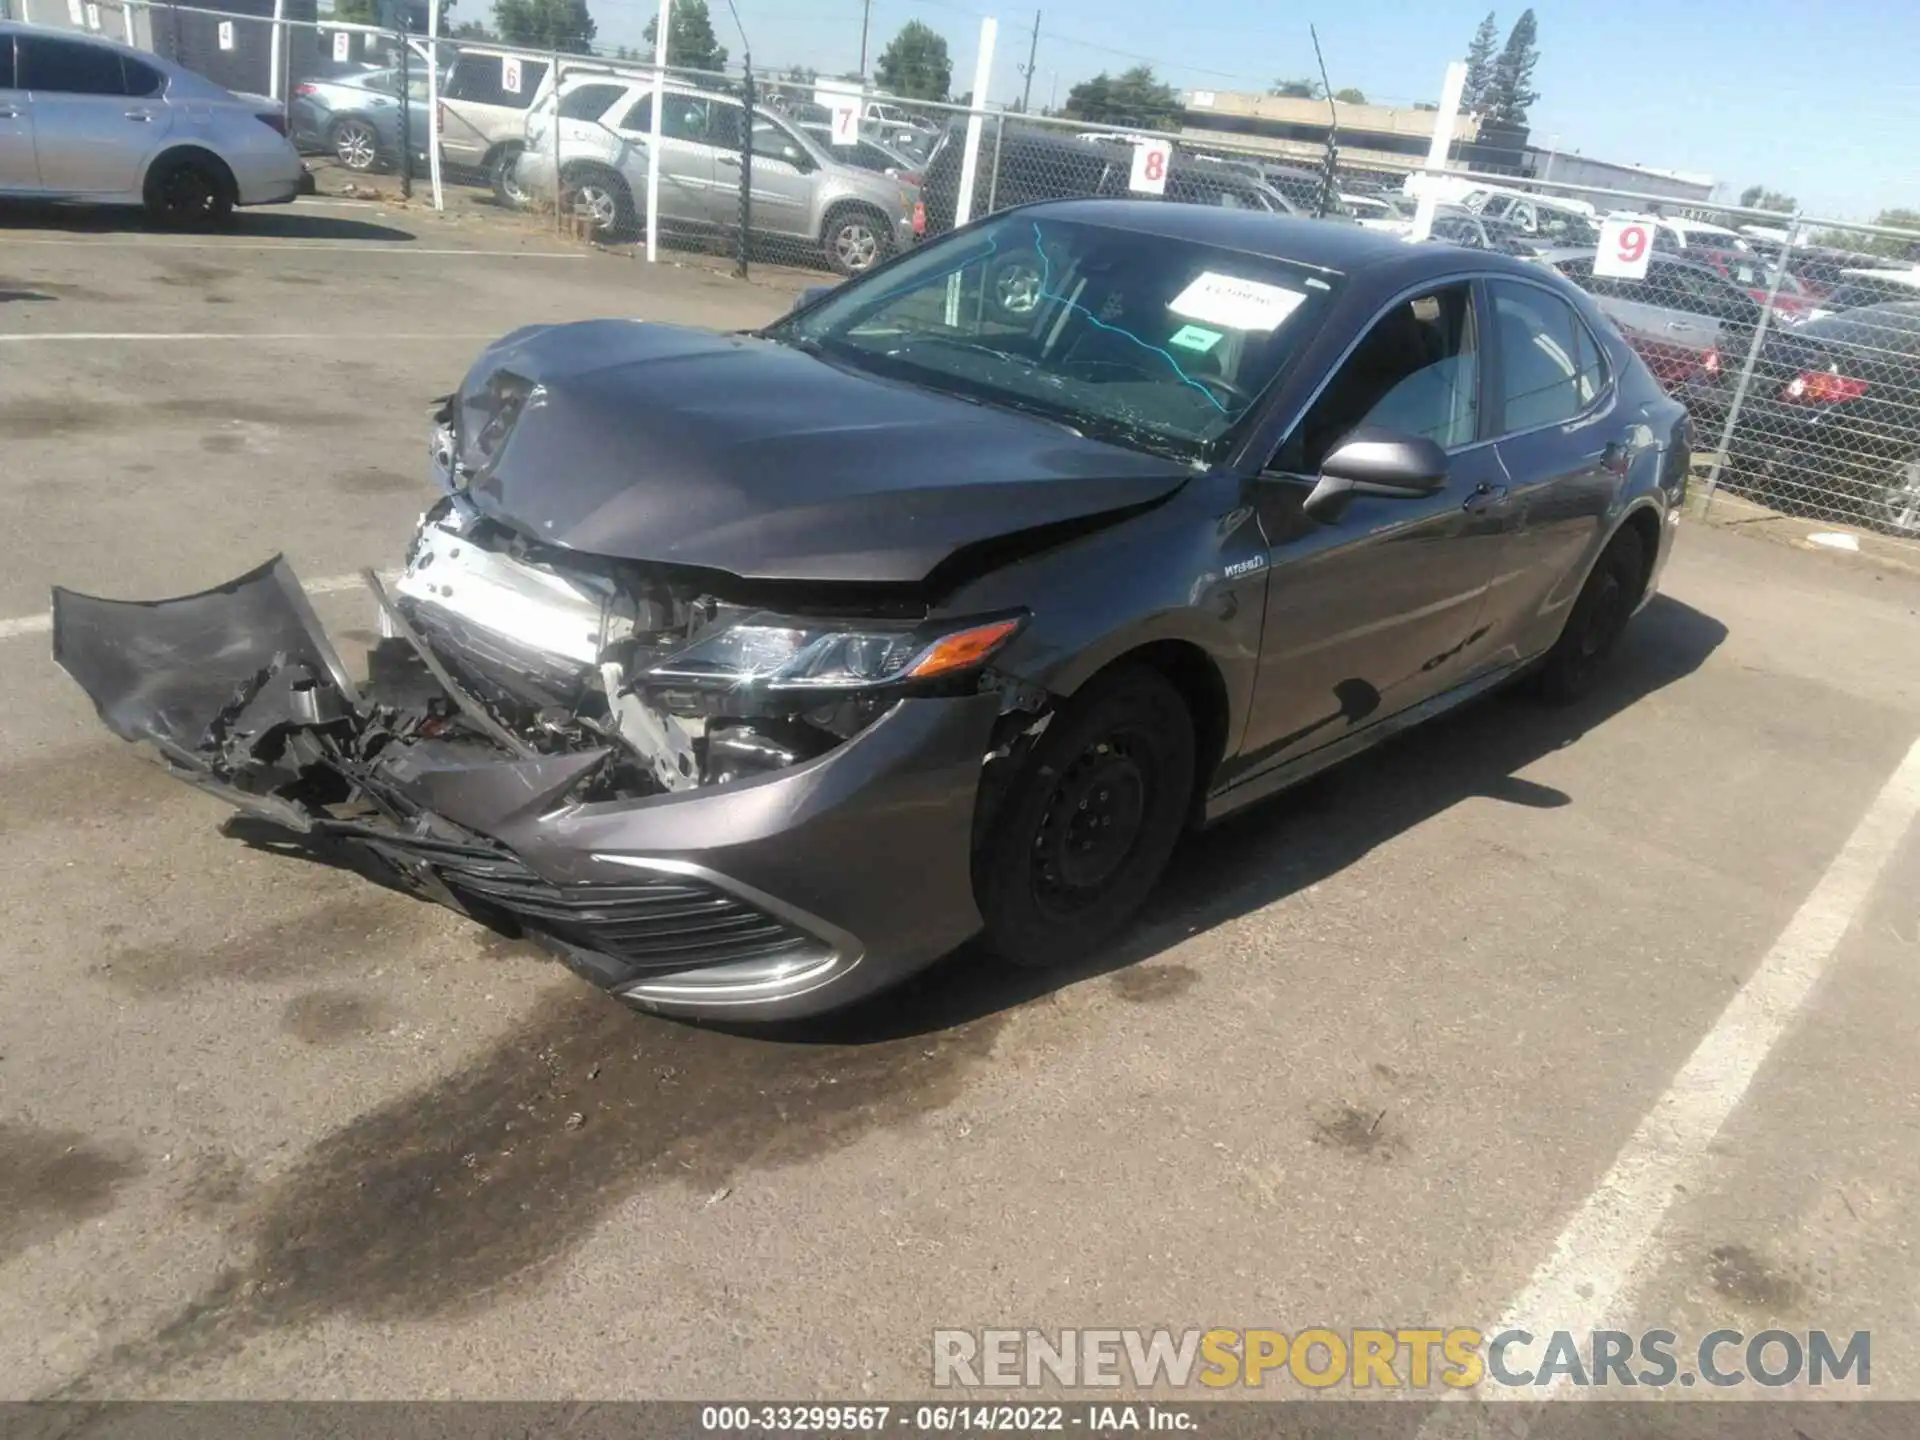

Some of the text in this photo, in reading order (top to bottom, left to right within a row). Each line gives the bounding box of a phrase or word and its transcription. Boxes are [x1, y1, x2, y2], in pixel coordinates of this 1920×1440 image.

[506, 67, 517, 89] 6
[838, 108, 853, 134] 7
[1145, 151, 1164, 181] 8
[1617, 226, 1646, 263] 9
